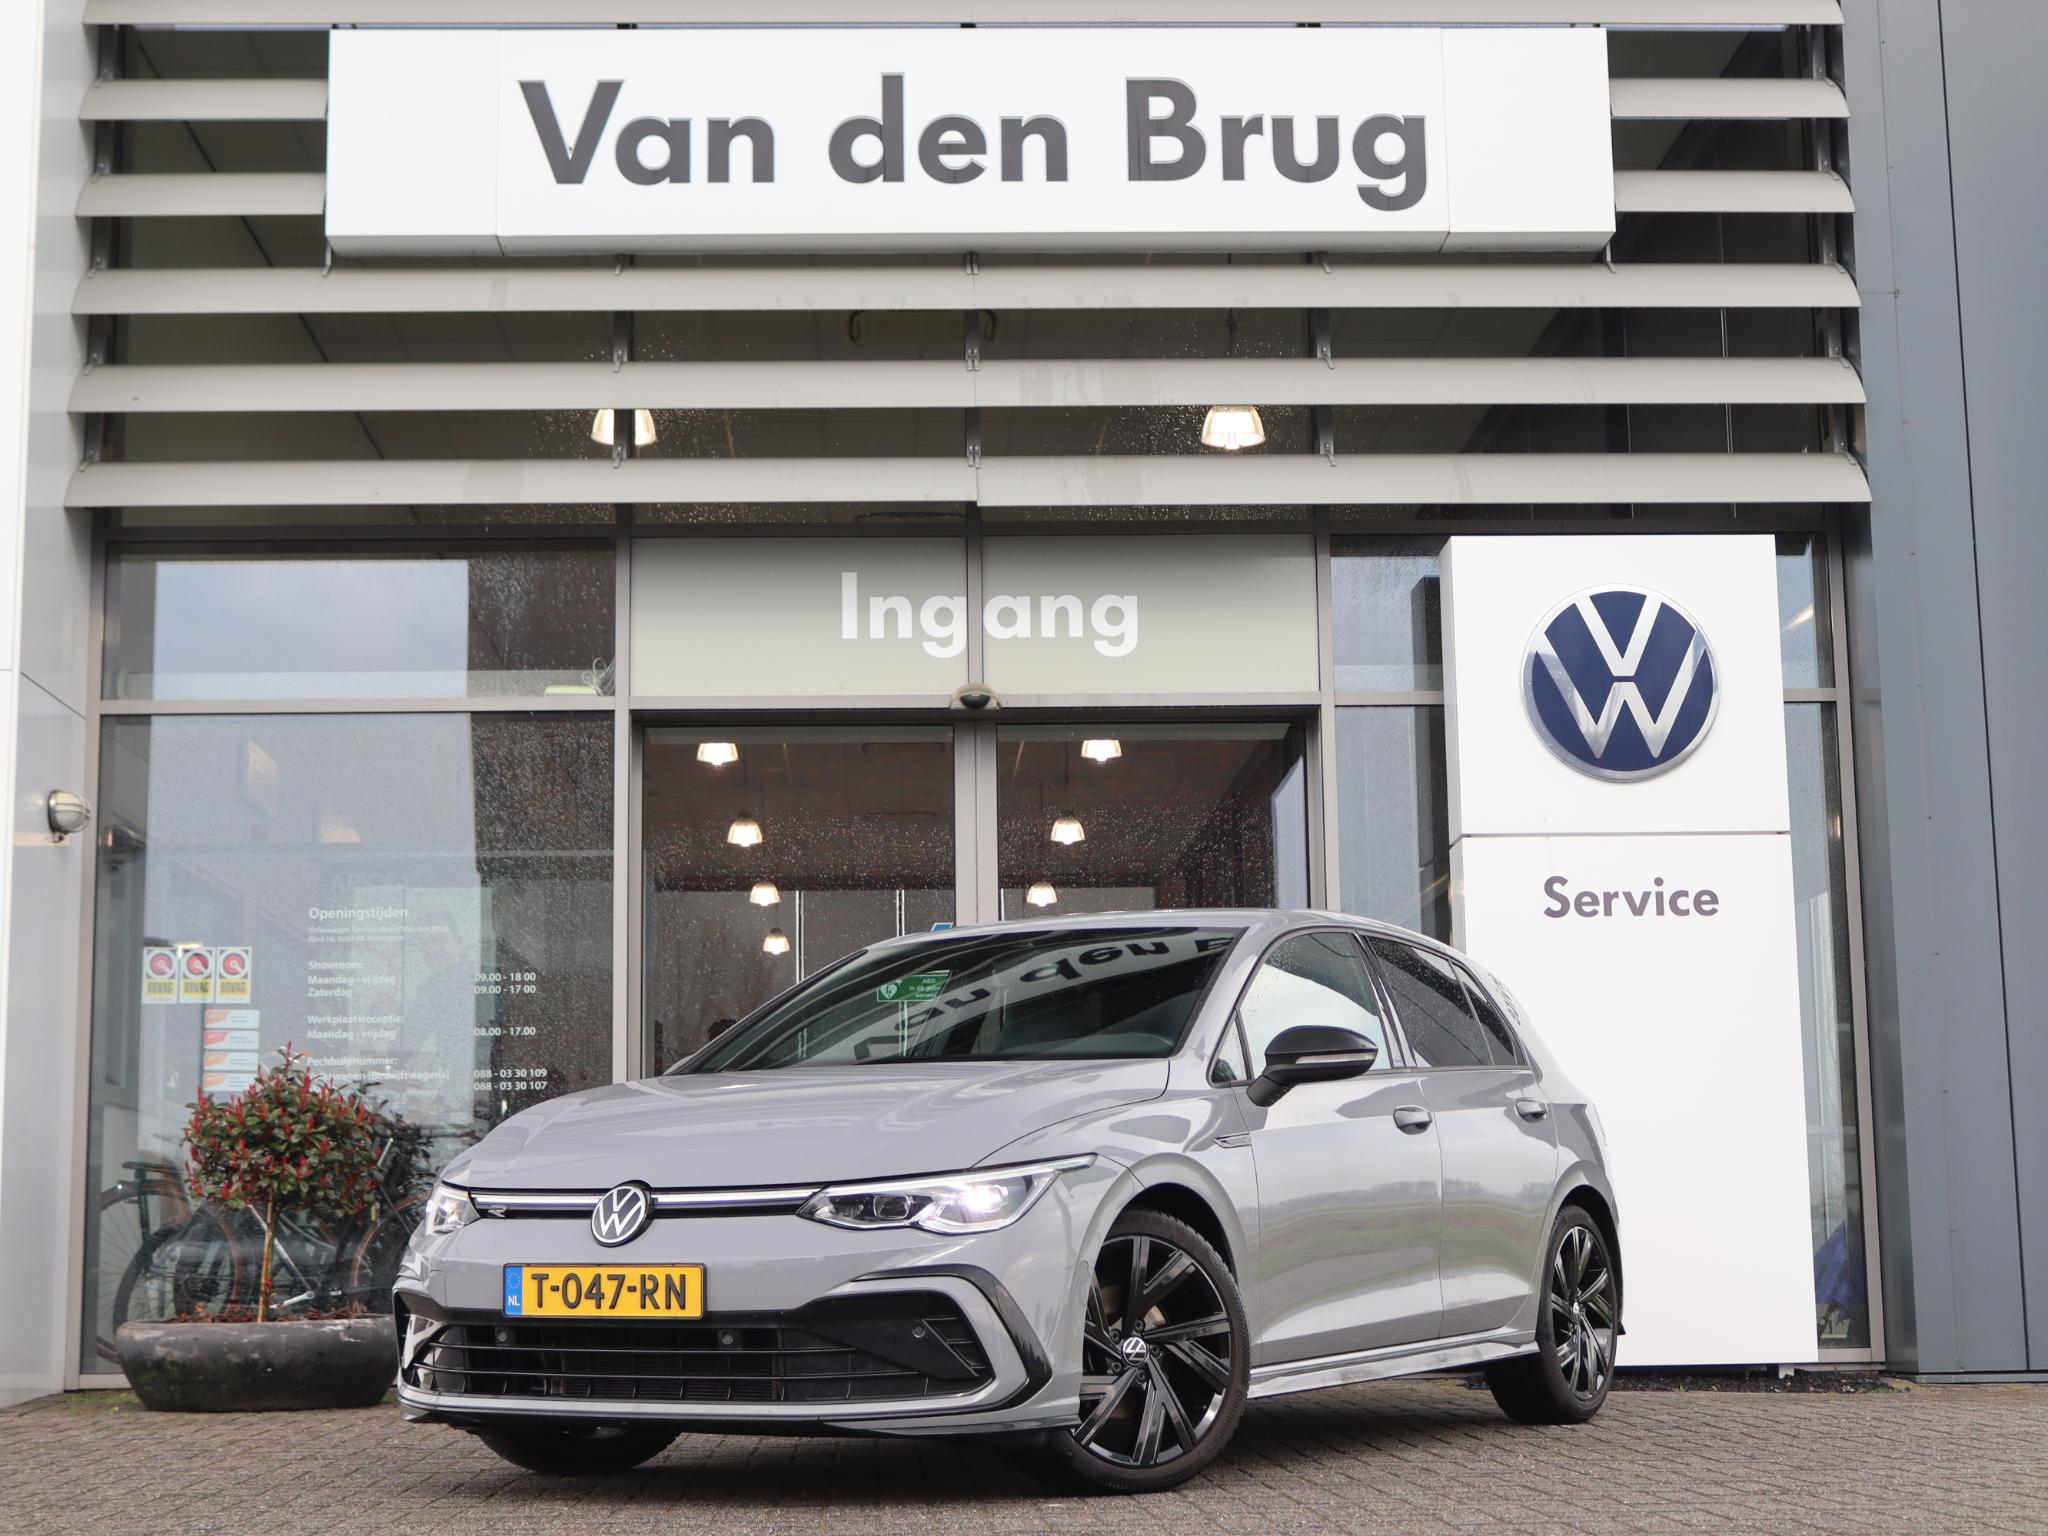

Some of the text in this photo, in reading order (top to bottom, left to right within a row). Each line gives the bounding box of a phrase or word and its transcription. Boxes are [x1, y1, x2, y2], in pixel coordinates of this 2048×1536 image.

[519, 74, 1427, 211] Van den Brug
[842, 571, 1138, 658] Ingang
[1544, 876, 1719, 918] Service
[308, 907, 408, 921] Openingstijden
[307, 975, 354, 986] Maandag
[307, 988, 352, 998] Zaterdag
[474, 985, 501, 993] 09.00
[307, 1030, 354, 1041] Maandag
[474, 1027, 501, 1036] 08.00
[510, 1027, 536, 1036] 17.00
[473, 1070, 492, 1079] 088
[500, 1069, 512, 1078] 03
[515, 1069, 527, 1078] 30
[530, 1068, 548, 1077] 109
[473, 1082, 492, 1091] 088
[500, 1081, 512, 1090] 03
[515, 1081, 527, 1090] 30
[530, 1080, 548, 1089] 107
[531, 1273, 686, 1309] T-047-RN
[508, 1295, 520, 1306] NL
